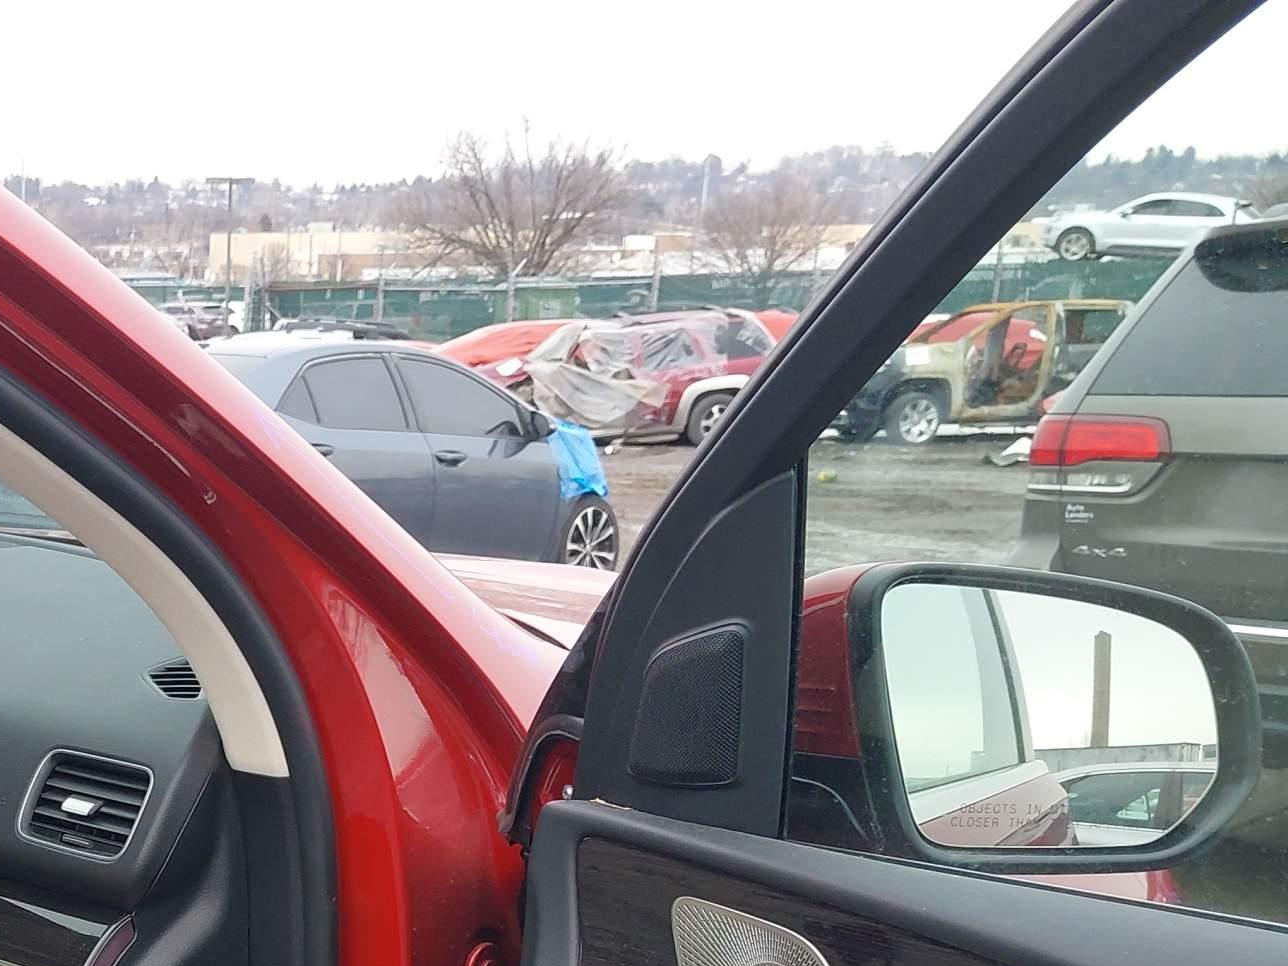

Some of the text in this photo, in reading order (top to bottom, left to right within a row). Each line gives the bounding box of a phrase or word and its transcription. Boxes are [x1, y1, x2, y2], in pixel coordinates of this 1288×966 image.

[959, 803, 1017, 815] OBJECTS
[1027, 803, 1042, 815] IN
[950, 816, 1000, 828] CLOSER
[1008, 816, 1040, 828] THA
